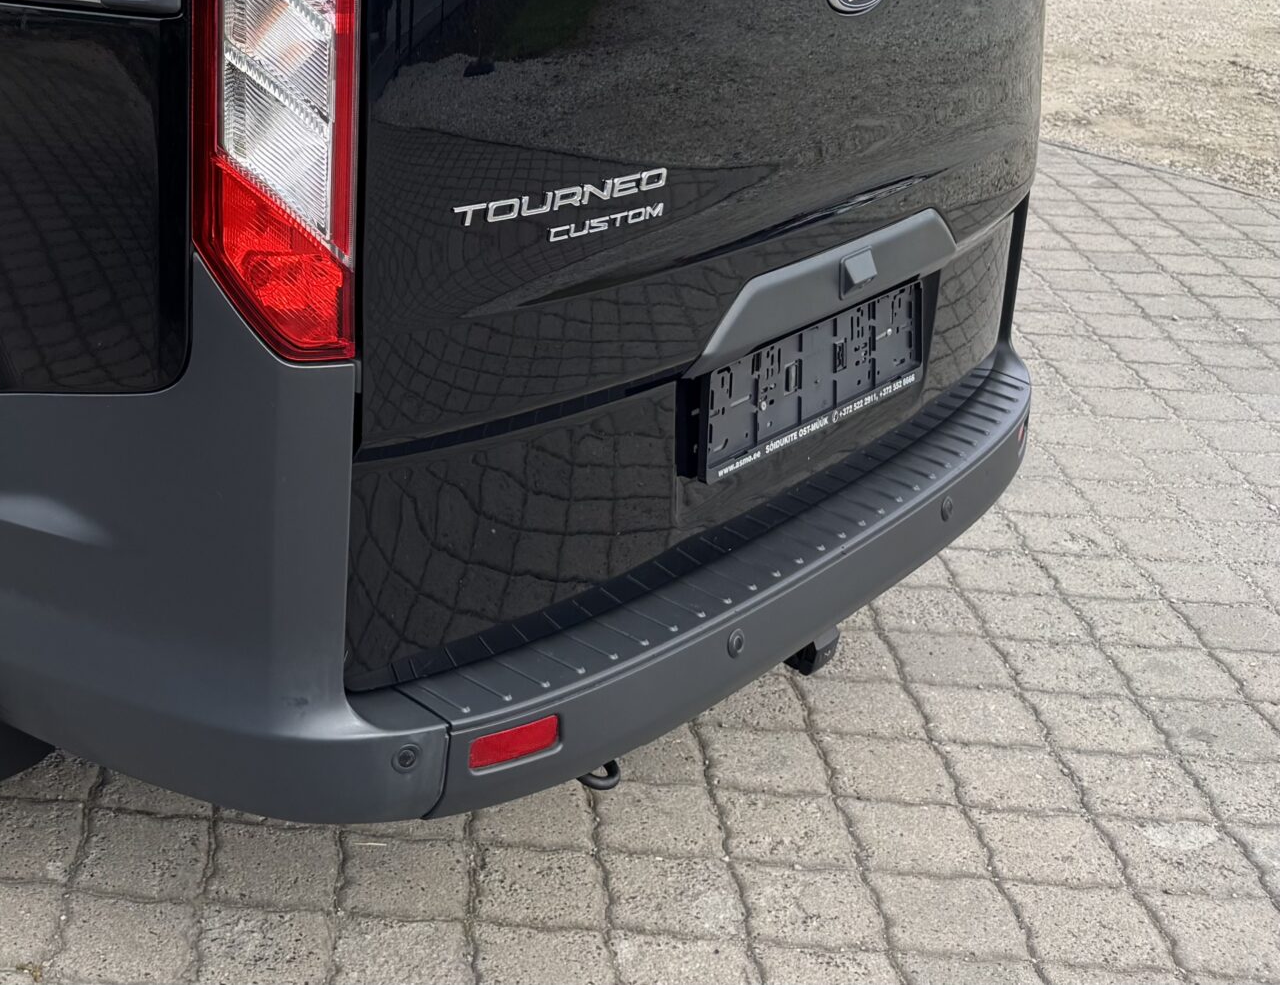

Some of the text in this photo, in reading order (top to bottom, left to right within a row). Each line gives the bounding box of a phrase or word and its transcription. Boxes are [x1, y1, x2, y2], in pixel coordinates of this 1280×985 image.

[453, 167, 668, 227] TOURNEO
[548, 202, 665, 242] CUSTOM
[717, 451, 762, 477] www.asmo.ee
